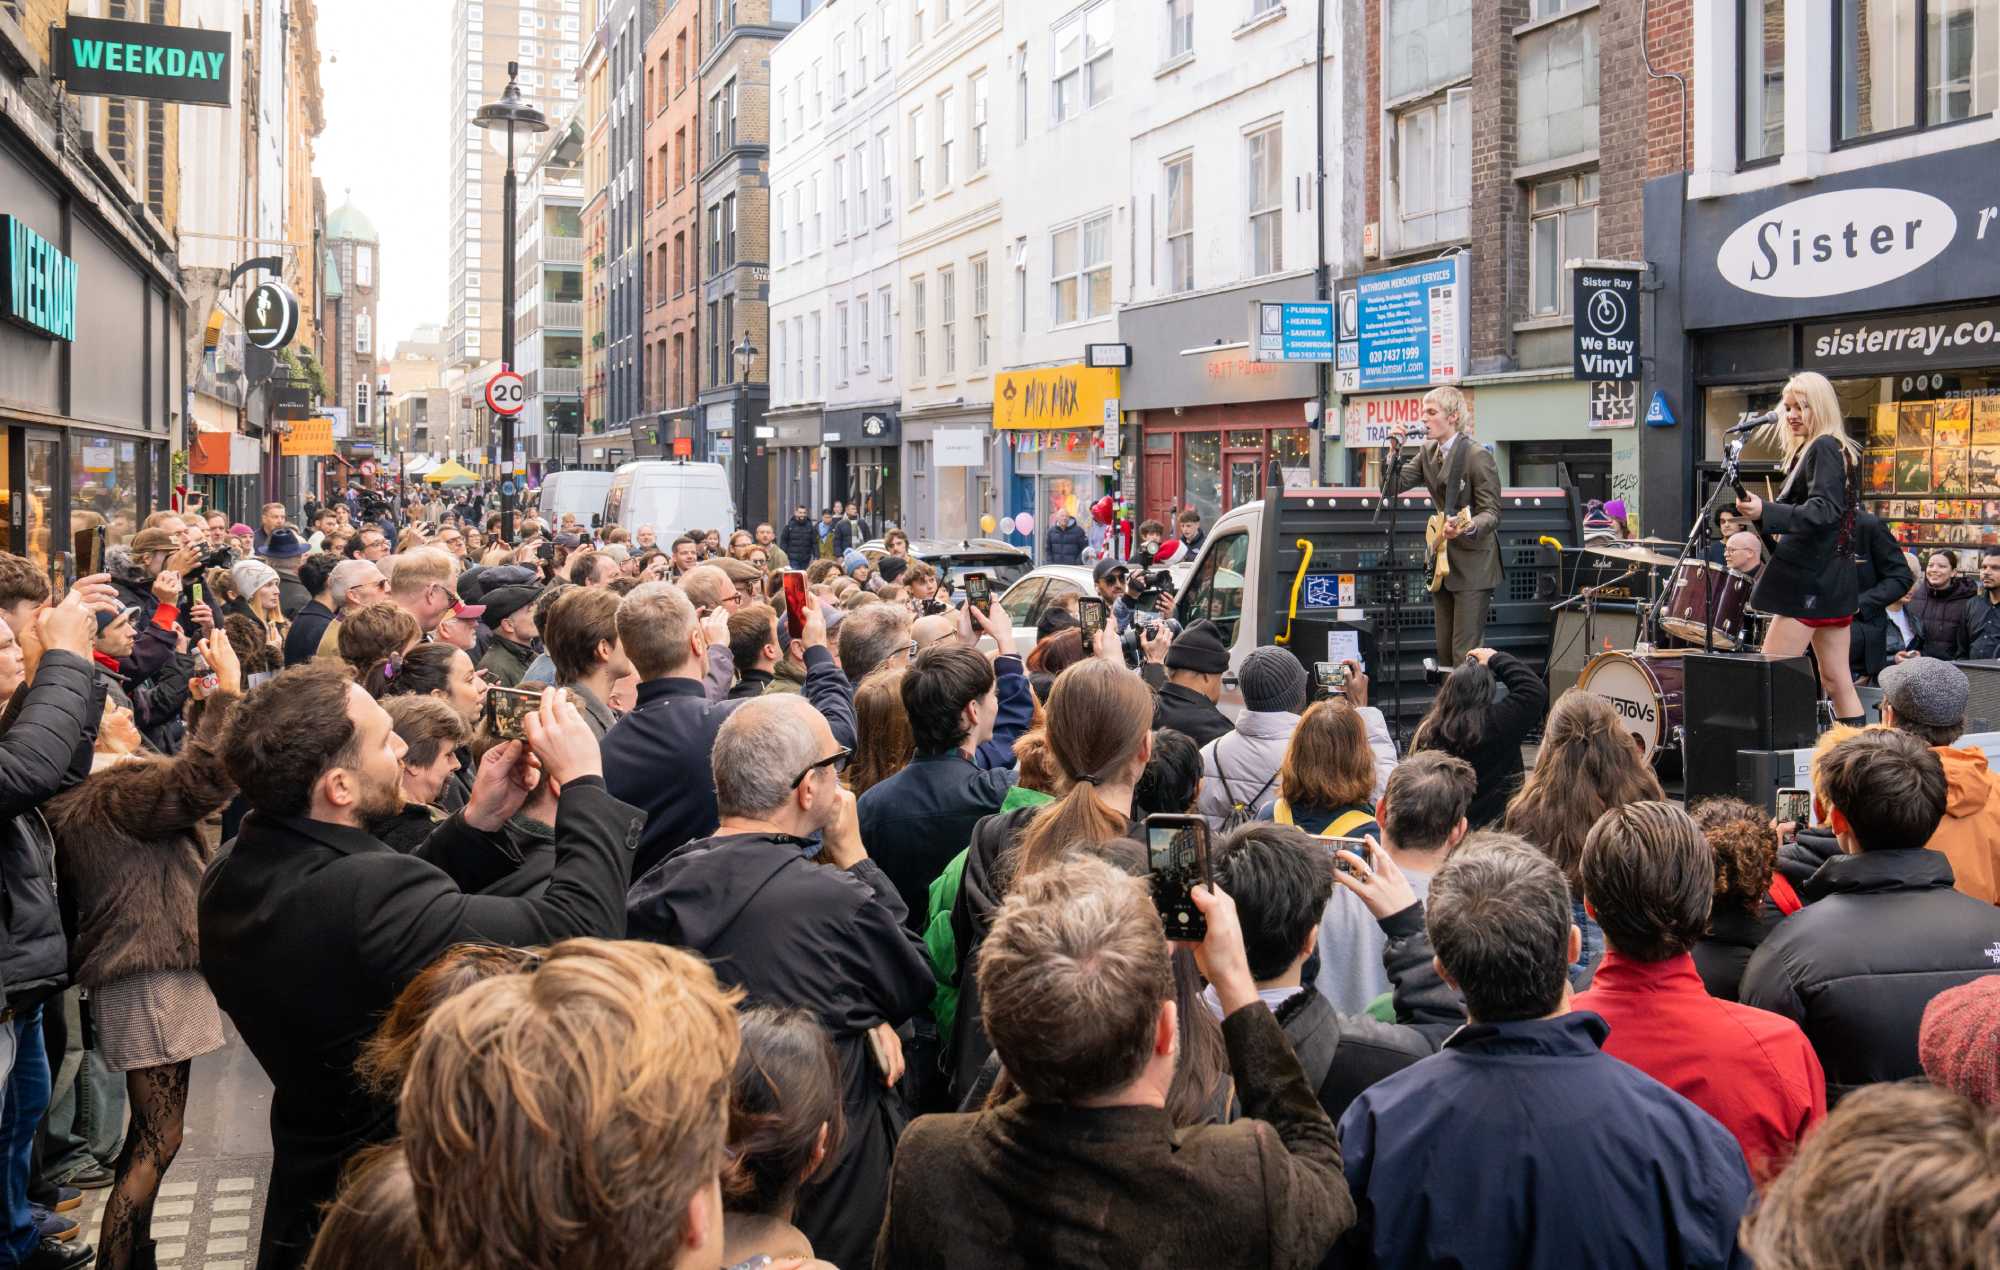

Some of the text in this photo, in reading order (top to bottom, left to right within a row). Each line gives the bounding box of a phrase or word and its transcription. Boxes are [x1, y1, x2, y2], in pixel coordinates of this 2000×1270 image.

[72, 38, 224, 80] WEEKDAY
[1750, 219, 1922, 282] Sister
[9, 213, 79, 342] WEEKDAY
[1361, 269, 1450, 294] BATHROOM MERCHANT SERVICES
[1582, 277, 1633, 290] Sister Ray
[1290, 306, 1329, 314] PLUMBING
[1340, 345, 1357, 363] BMS
[1581, 337, 1634, 353] We Buy
[1369, 346, 1419, 364] 020 7437 1999
[1365, 362, 1424, 377] www.bmsw1.com
[1581, 354, 1633, 378] Vinyl
[1342, 373, 1353, 386] 76
[494, 384, 523, 402] 20
[1024, 377, 1048, 420] MIX
[1592, 401, 1634, 420] LESS
